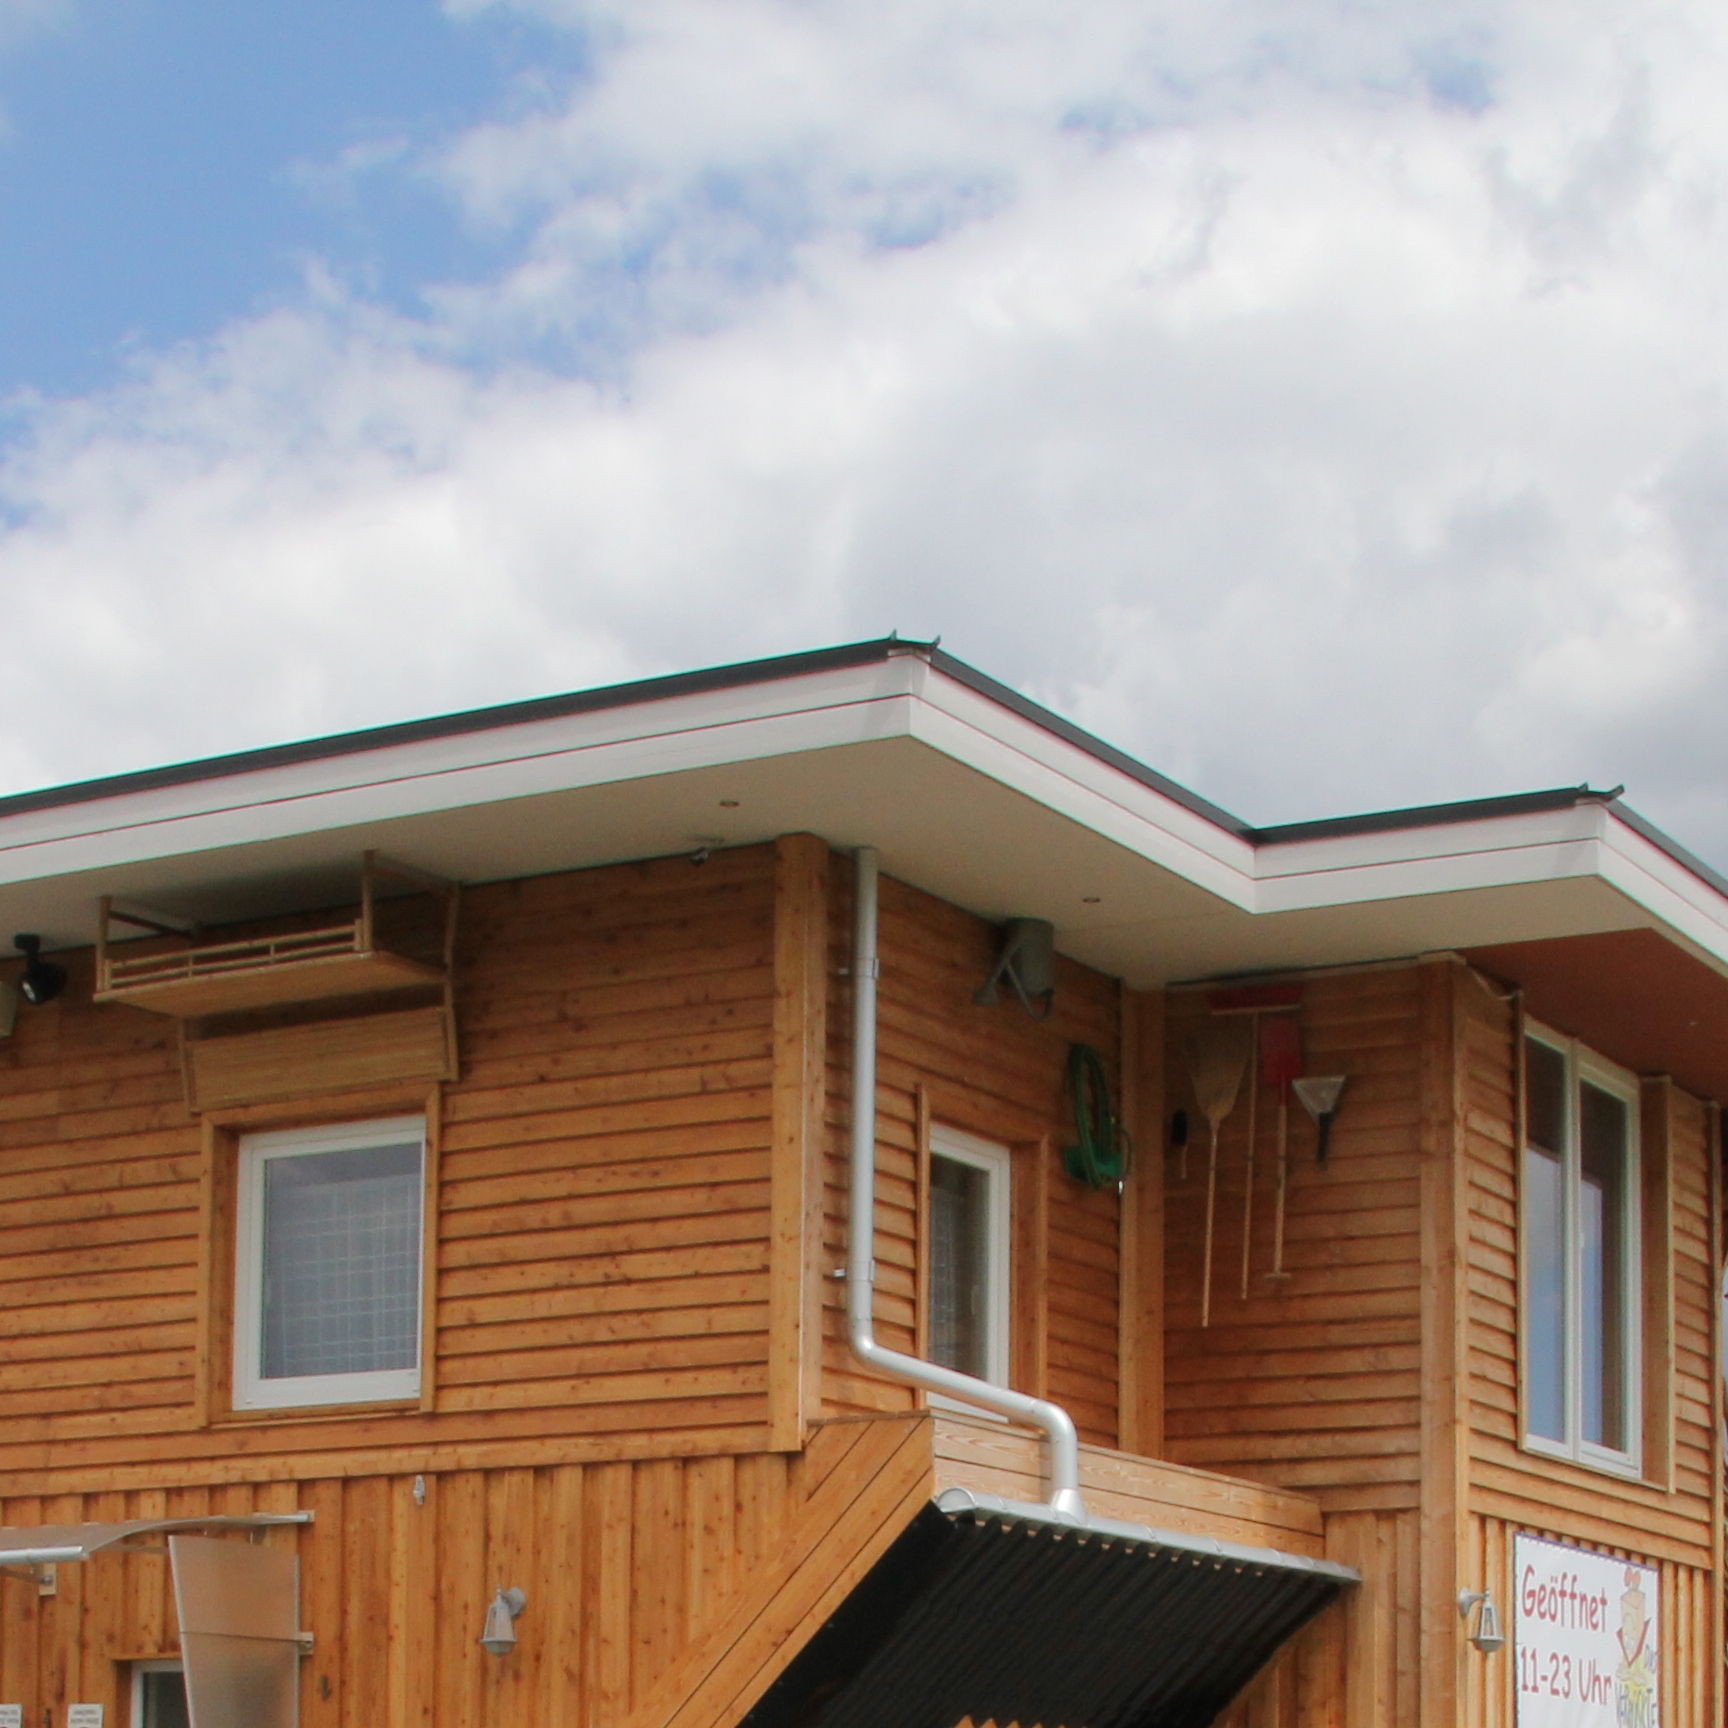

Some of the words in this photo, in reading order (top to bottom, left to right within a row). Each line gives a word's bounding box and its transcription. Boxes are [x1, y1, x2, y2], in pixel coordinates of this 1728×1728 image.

[1522, 1564, 1608, 1633] Geöffnet
[1521, 1646, 1572, 1699] 11-23
[1578, 1658, 1612, 1706] Uhr
